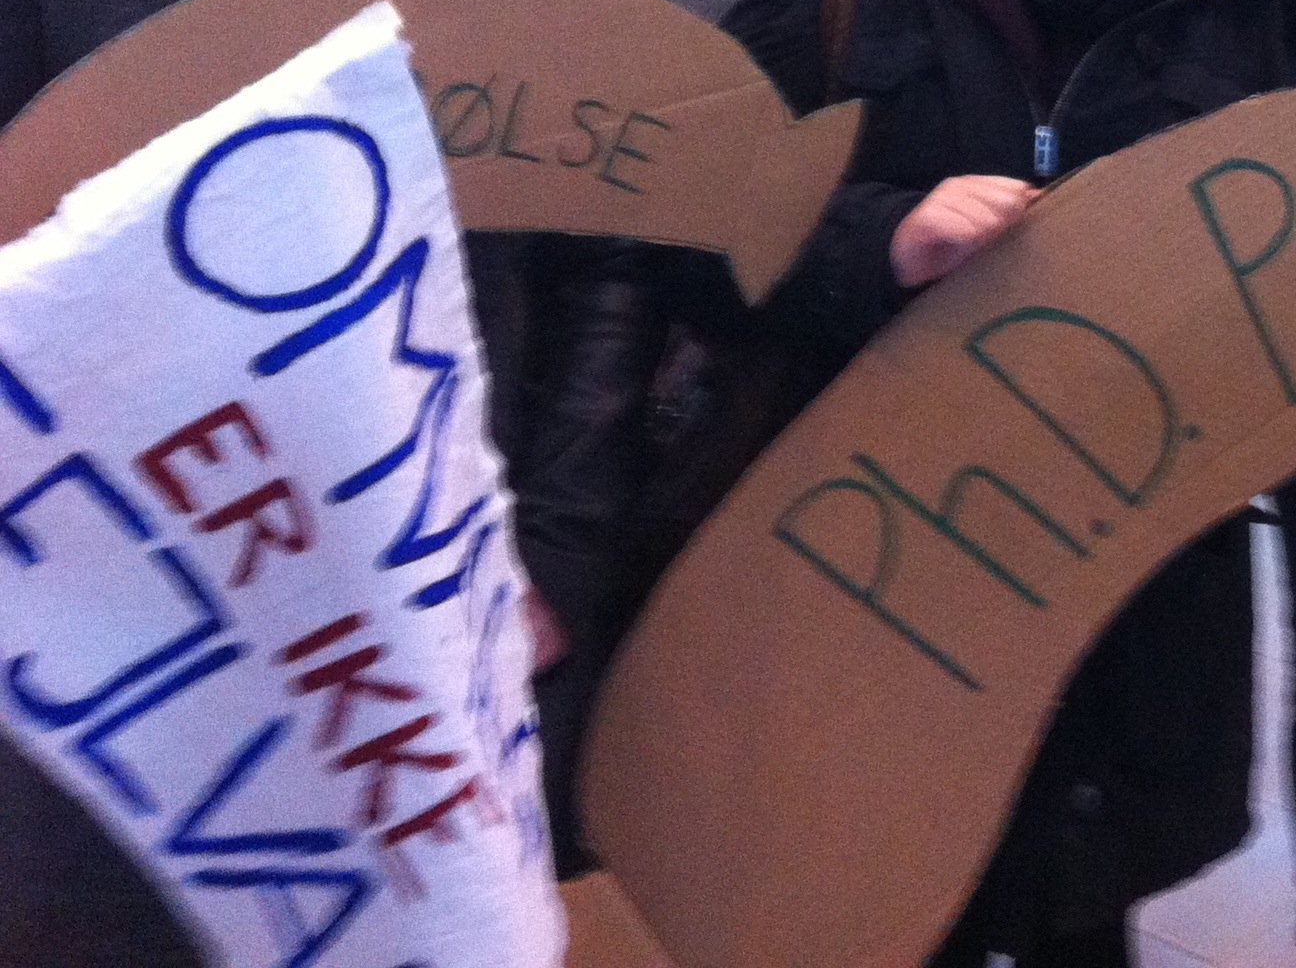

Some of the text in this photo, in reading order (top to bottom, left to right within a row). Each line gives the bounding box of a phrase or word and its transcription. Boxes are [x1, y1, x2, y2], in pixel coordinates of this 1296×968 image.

[408, 69, 672, 196] ØLSE
[132, 398, 508, 904] ER IKKE
